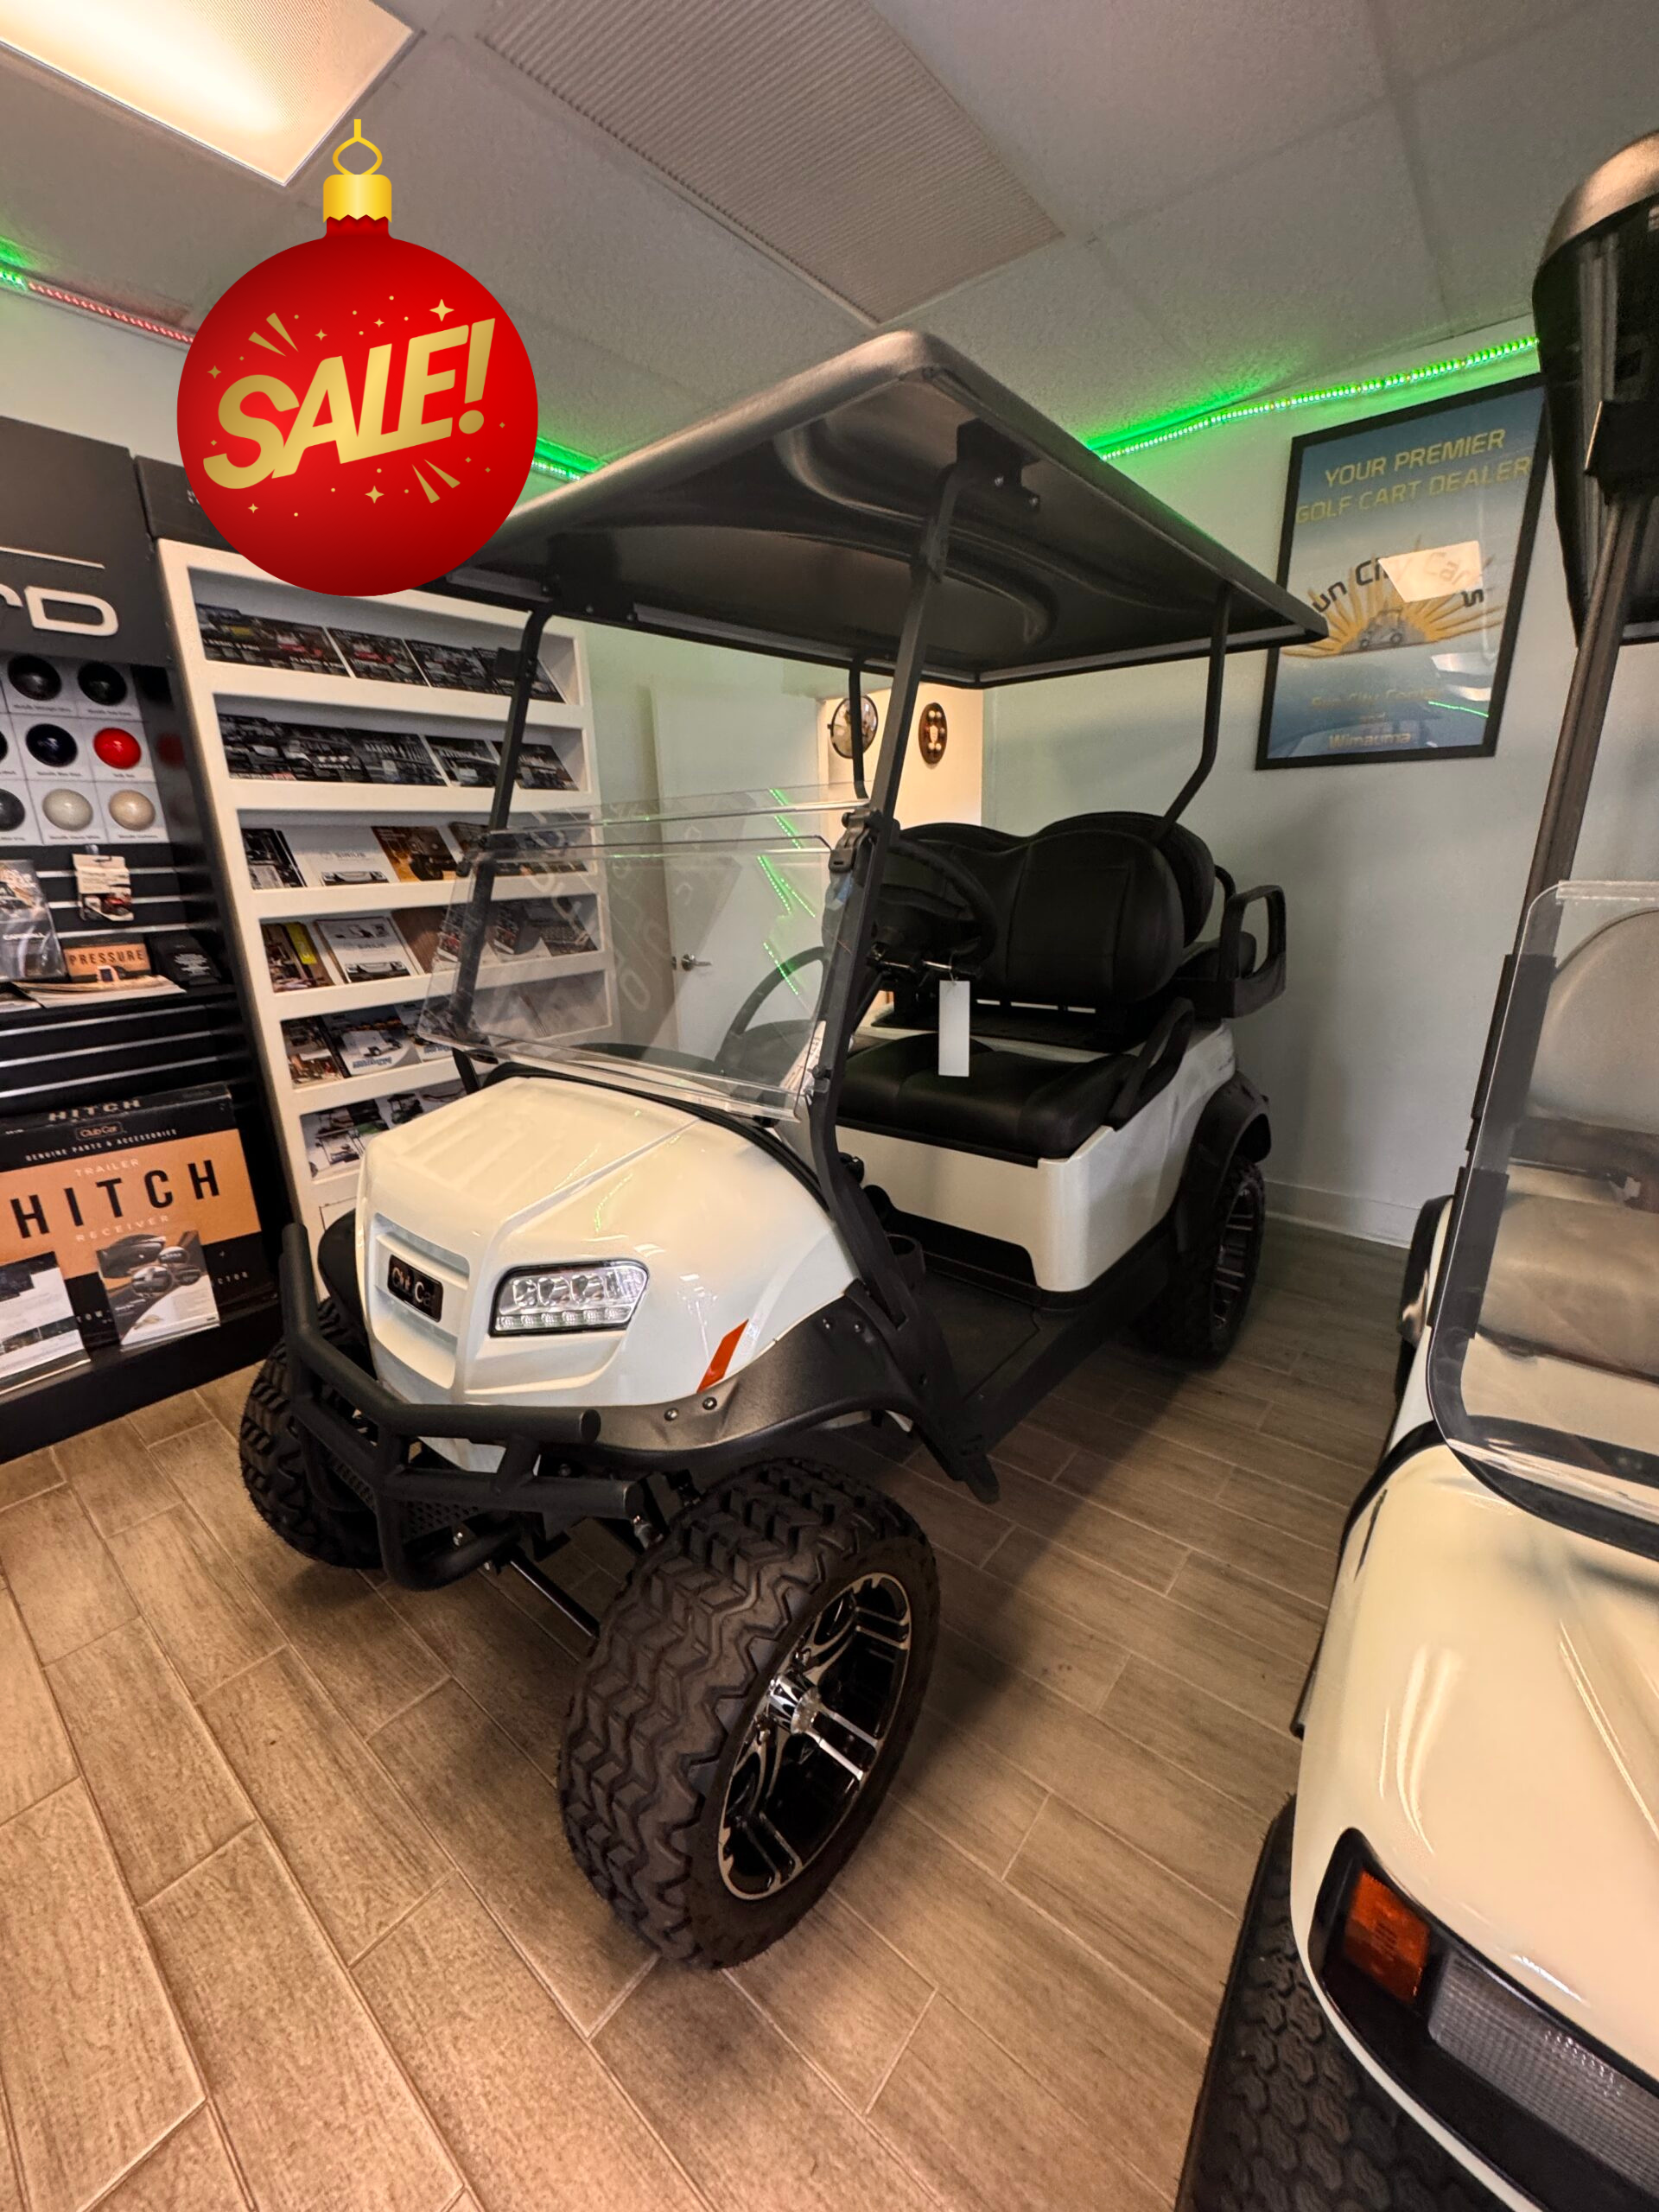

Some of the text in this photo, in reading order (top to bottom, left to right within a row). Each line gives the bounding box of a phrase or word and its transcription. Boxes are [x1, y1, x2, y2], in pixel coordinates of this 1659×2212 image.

[1325, 429, 1506, 489] YOUR PREMIER
[1295, 455, 1532, 524] GOLF CART DEALER
[1313, 581, 1348, 613] un
[68, 950, 144, 966] PRESSURE
[48, 1099, 142, 1122] HITCH
[72, 1141, 102, 1154] PARTS
[75, 1158, 140, 1177] TRAILER
[10, 1160, 219, 1239] HITCH
[76, 1215, 169, 1243] RECEIVER
